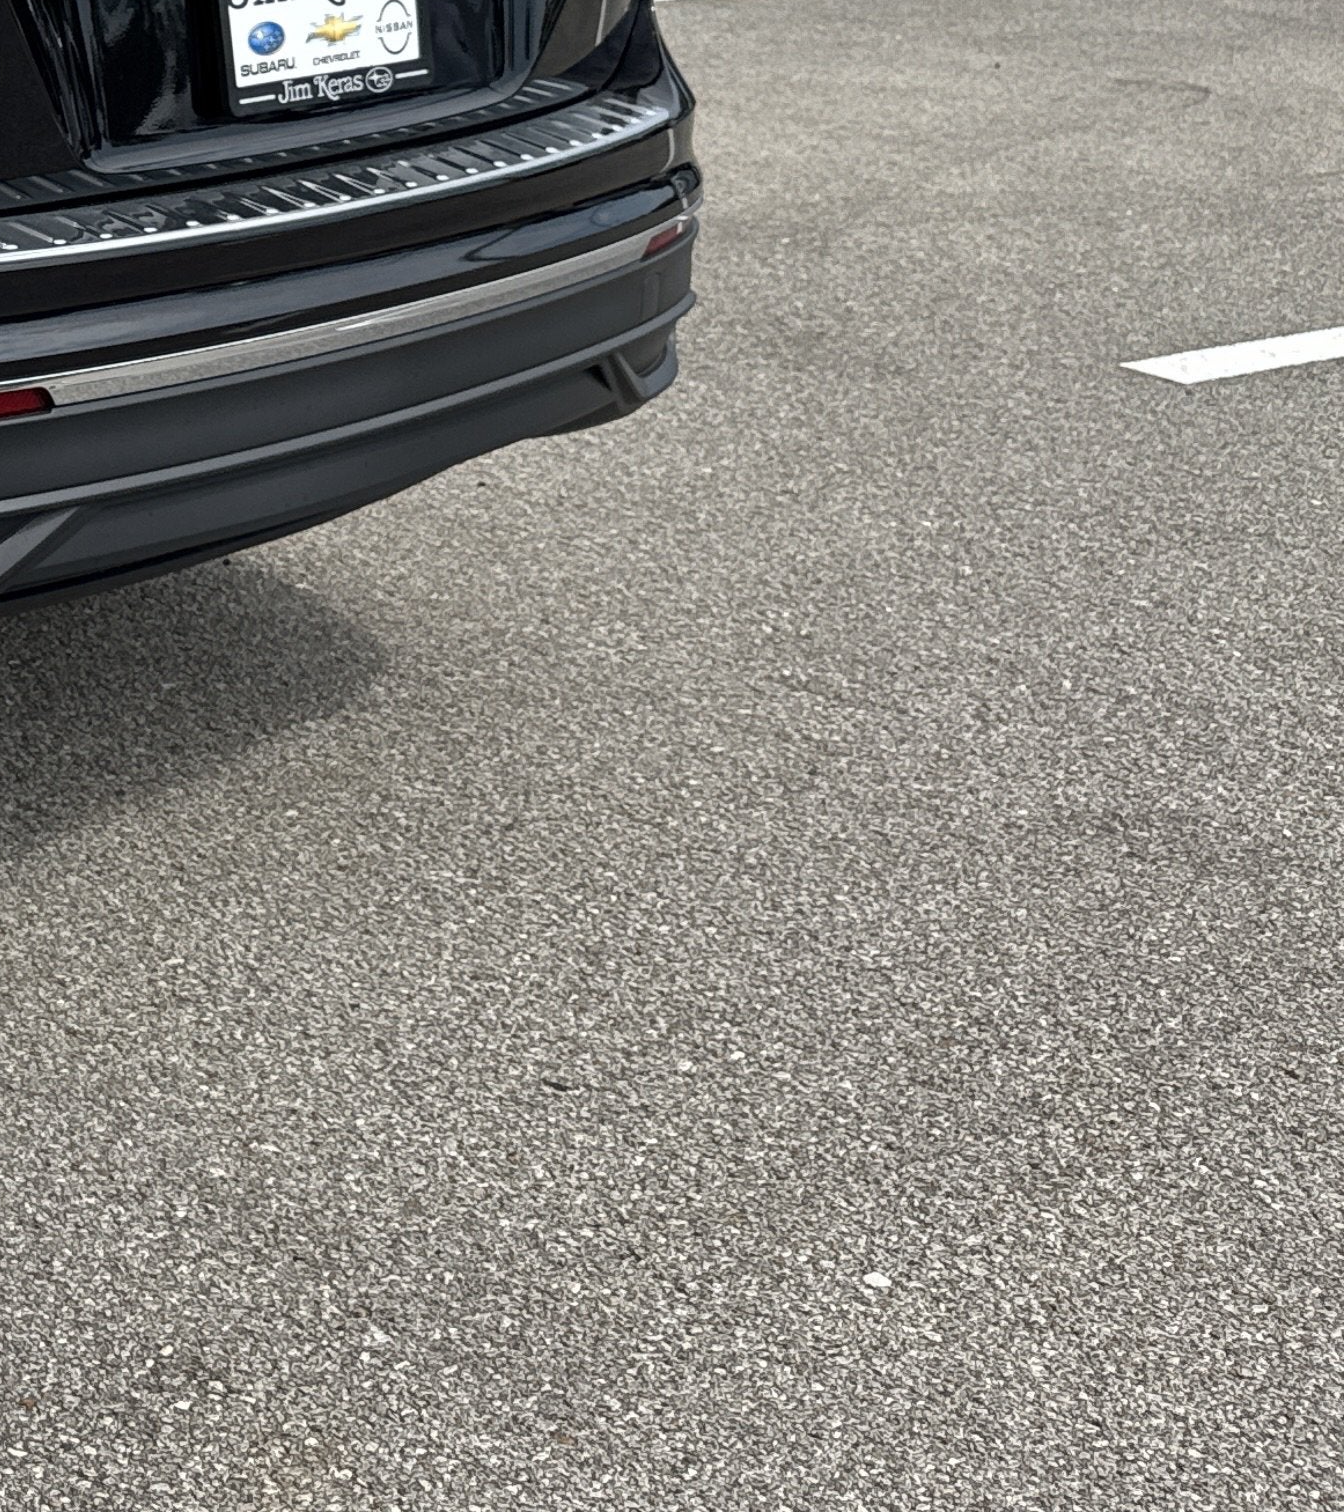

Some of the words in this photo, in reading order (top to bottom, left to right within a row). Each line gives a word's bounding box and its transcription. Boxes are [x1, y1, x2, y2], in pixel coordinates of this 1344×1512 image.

[375, 21, 413, 34] NISSAN
[240, 57, 296, 77] SUBARU
[313, 50, 360, 66] CHEVROLET
[277, 80, 313, 104] Jim
[313, 74, 364, 101] Keras
